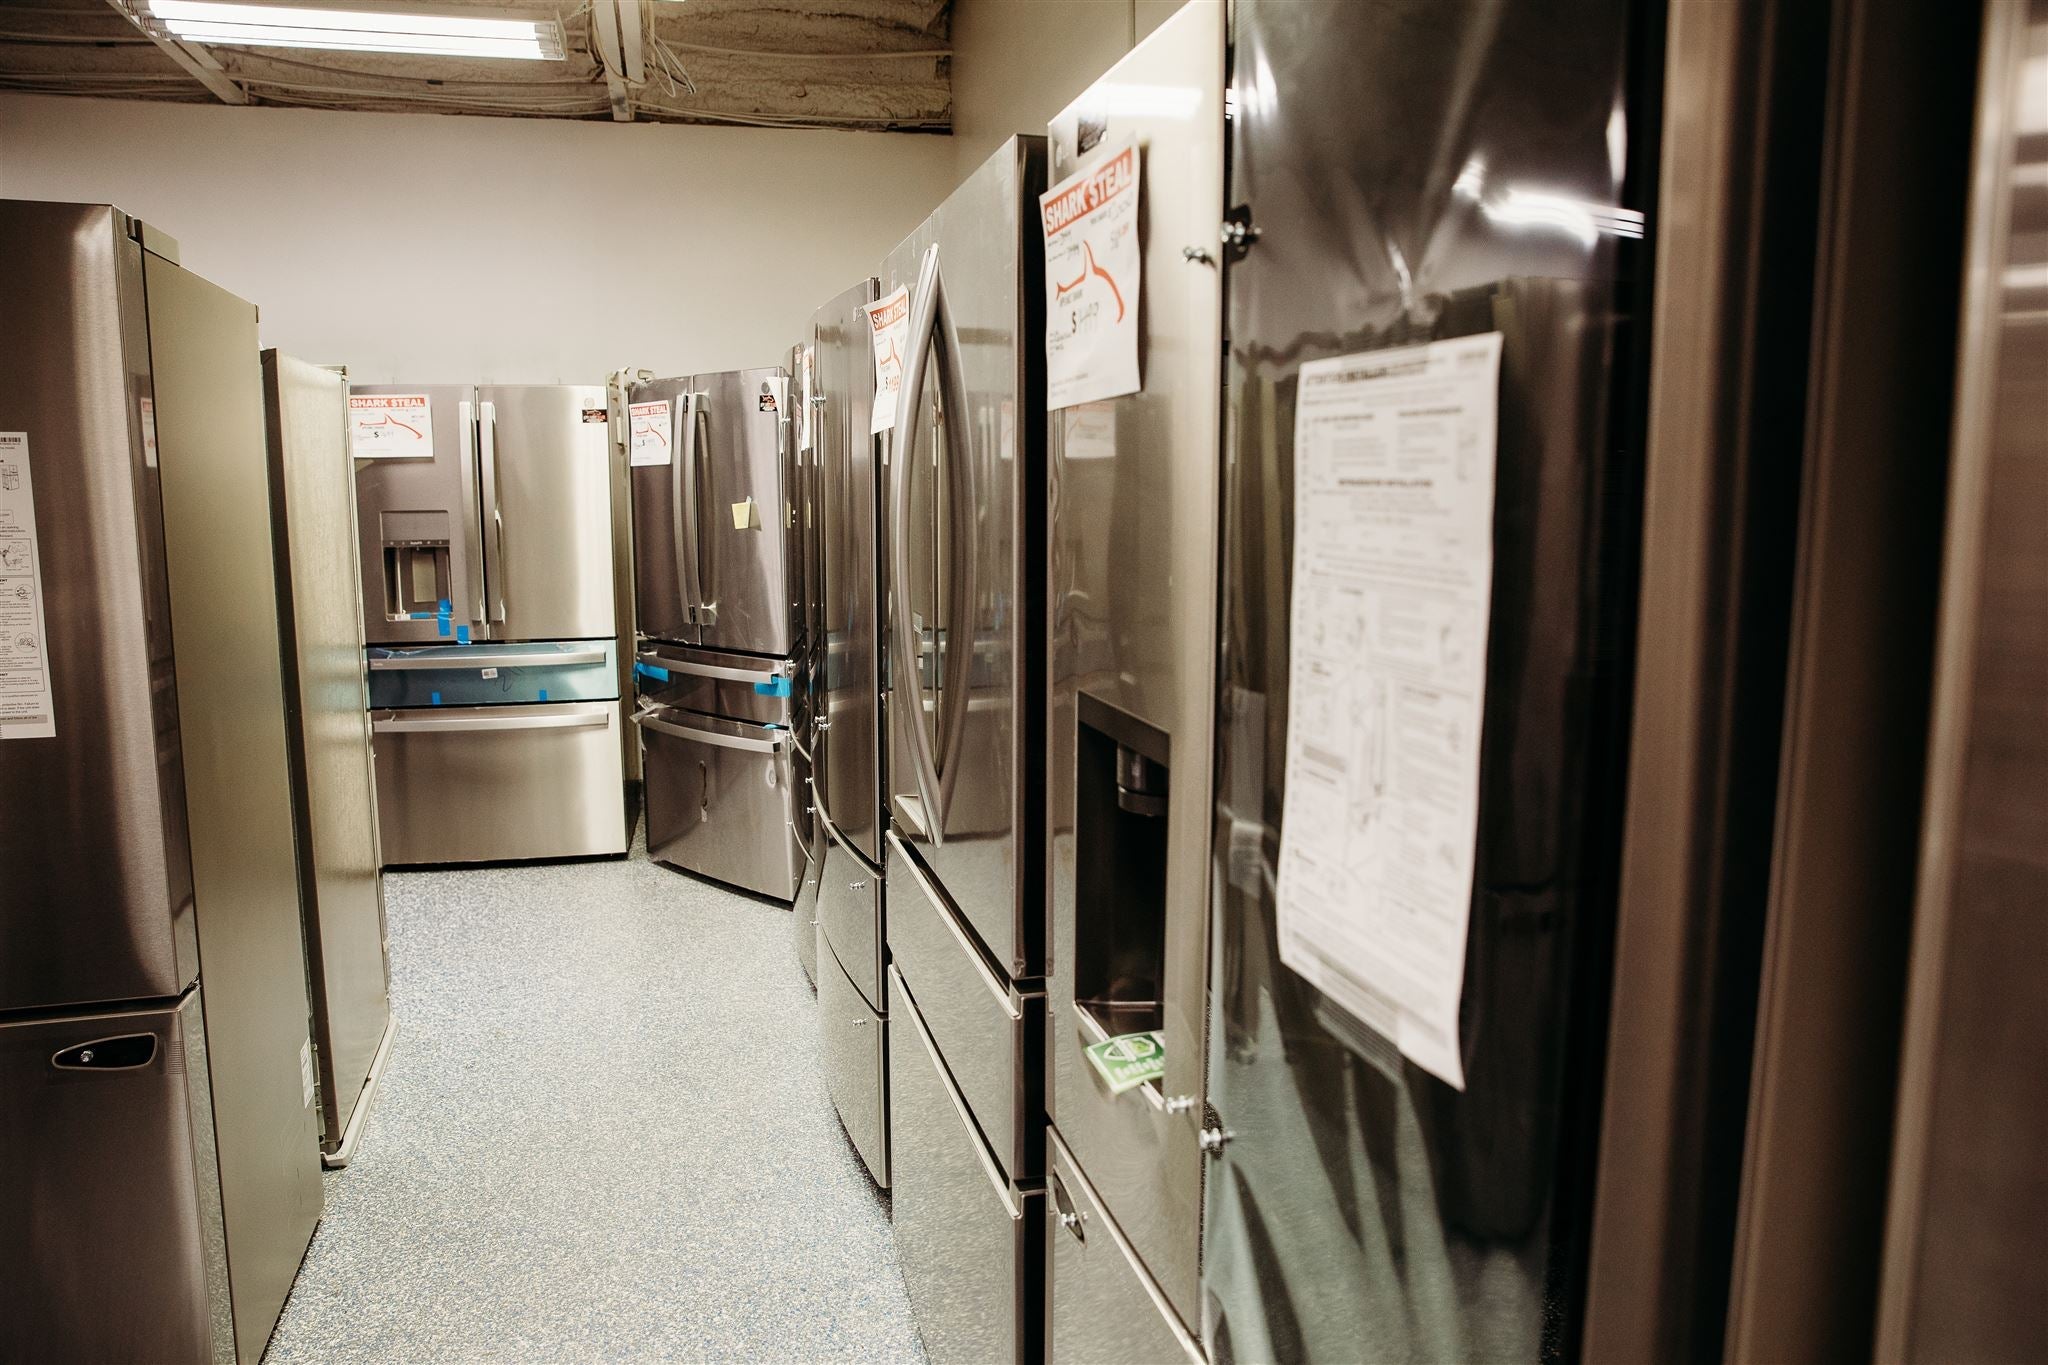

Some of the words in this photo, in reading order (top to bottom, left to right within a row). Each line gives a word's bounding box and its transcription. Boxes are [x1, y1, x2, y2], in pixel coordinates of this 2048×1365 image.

[1046, 184, 1089, 233] SHARK
[1090, 156, 1132, 206] STEAL
[872, 307, 893, 329] SHARK
[893, 299, 907, 320] STEAL
[350, 399, 388, 408] SHARK
[390, 398, 424, 407] STEAL
